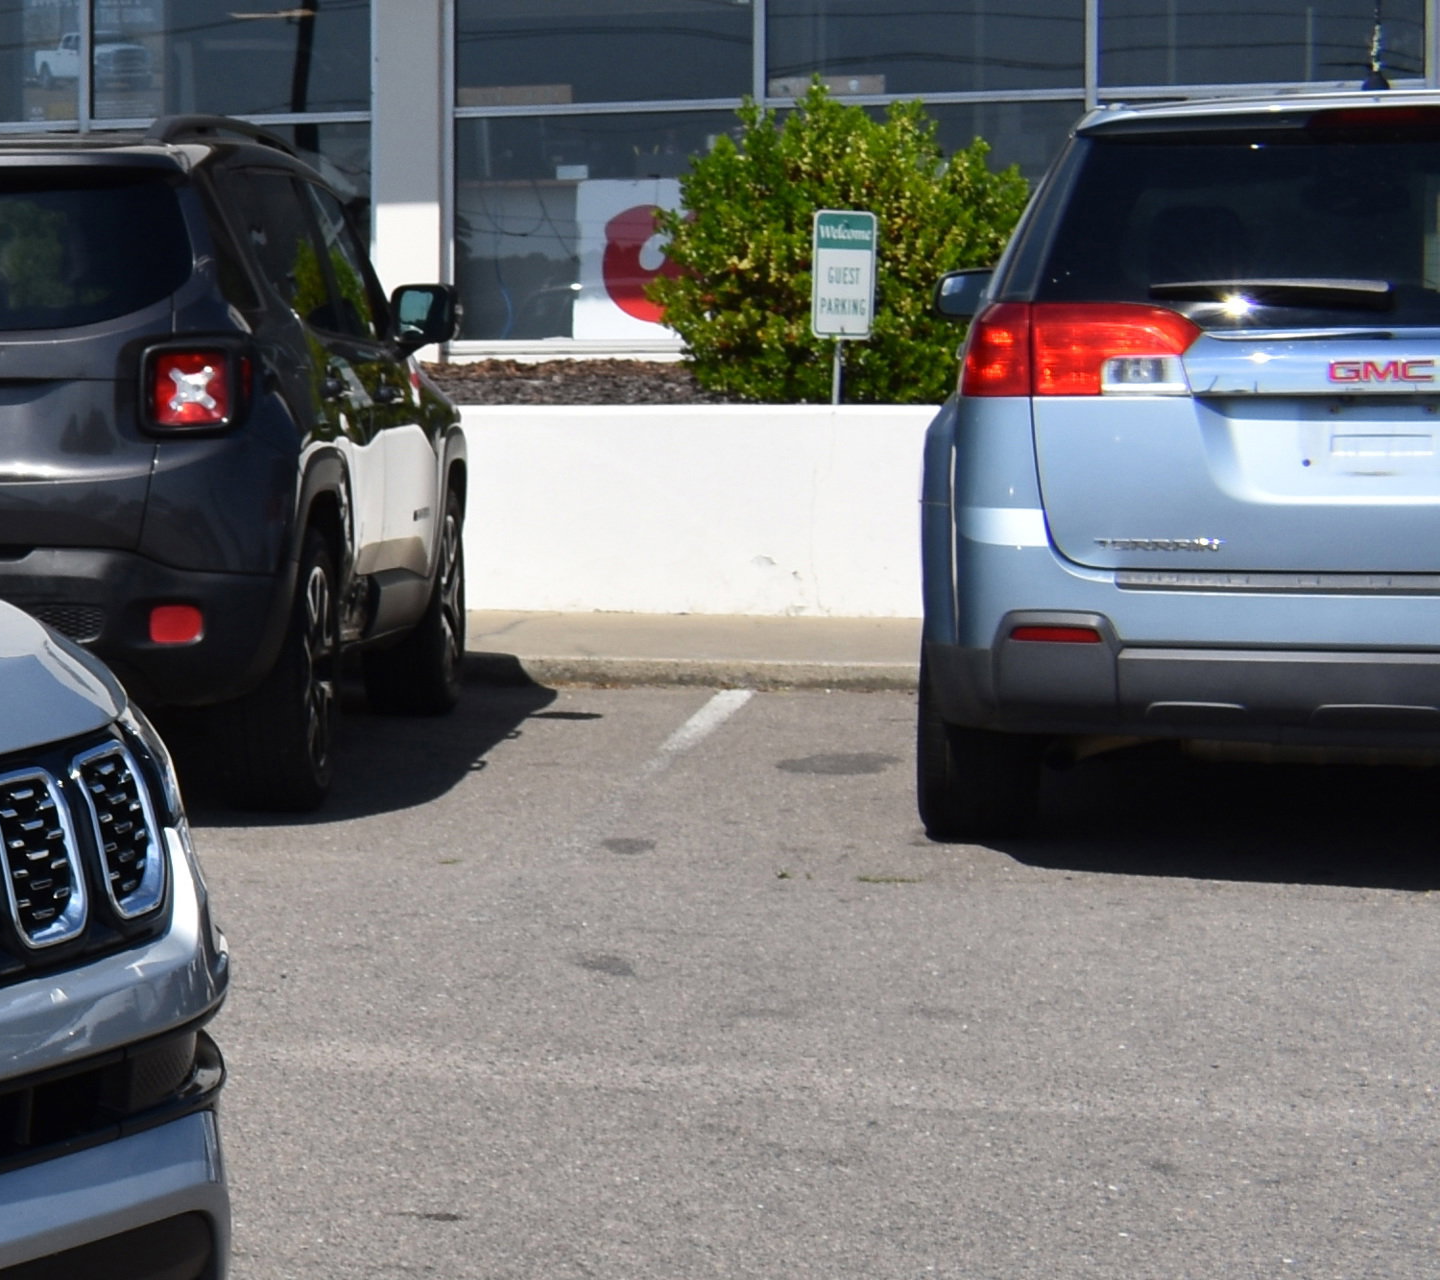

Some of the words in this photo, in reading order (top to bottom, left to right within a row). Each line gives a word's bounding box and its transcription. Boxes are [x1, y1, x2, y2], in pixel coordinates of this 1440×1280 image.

[819, 223, 872, 241] Welcome
[827, 266, 861, 285] GUEST
[820, 298, 866, 316] PARKING
[1328, 360, 1434, 383] GMC
